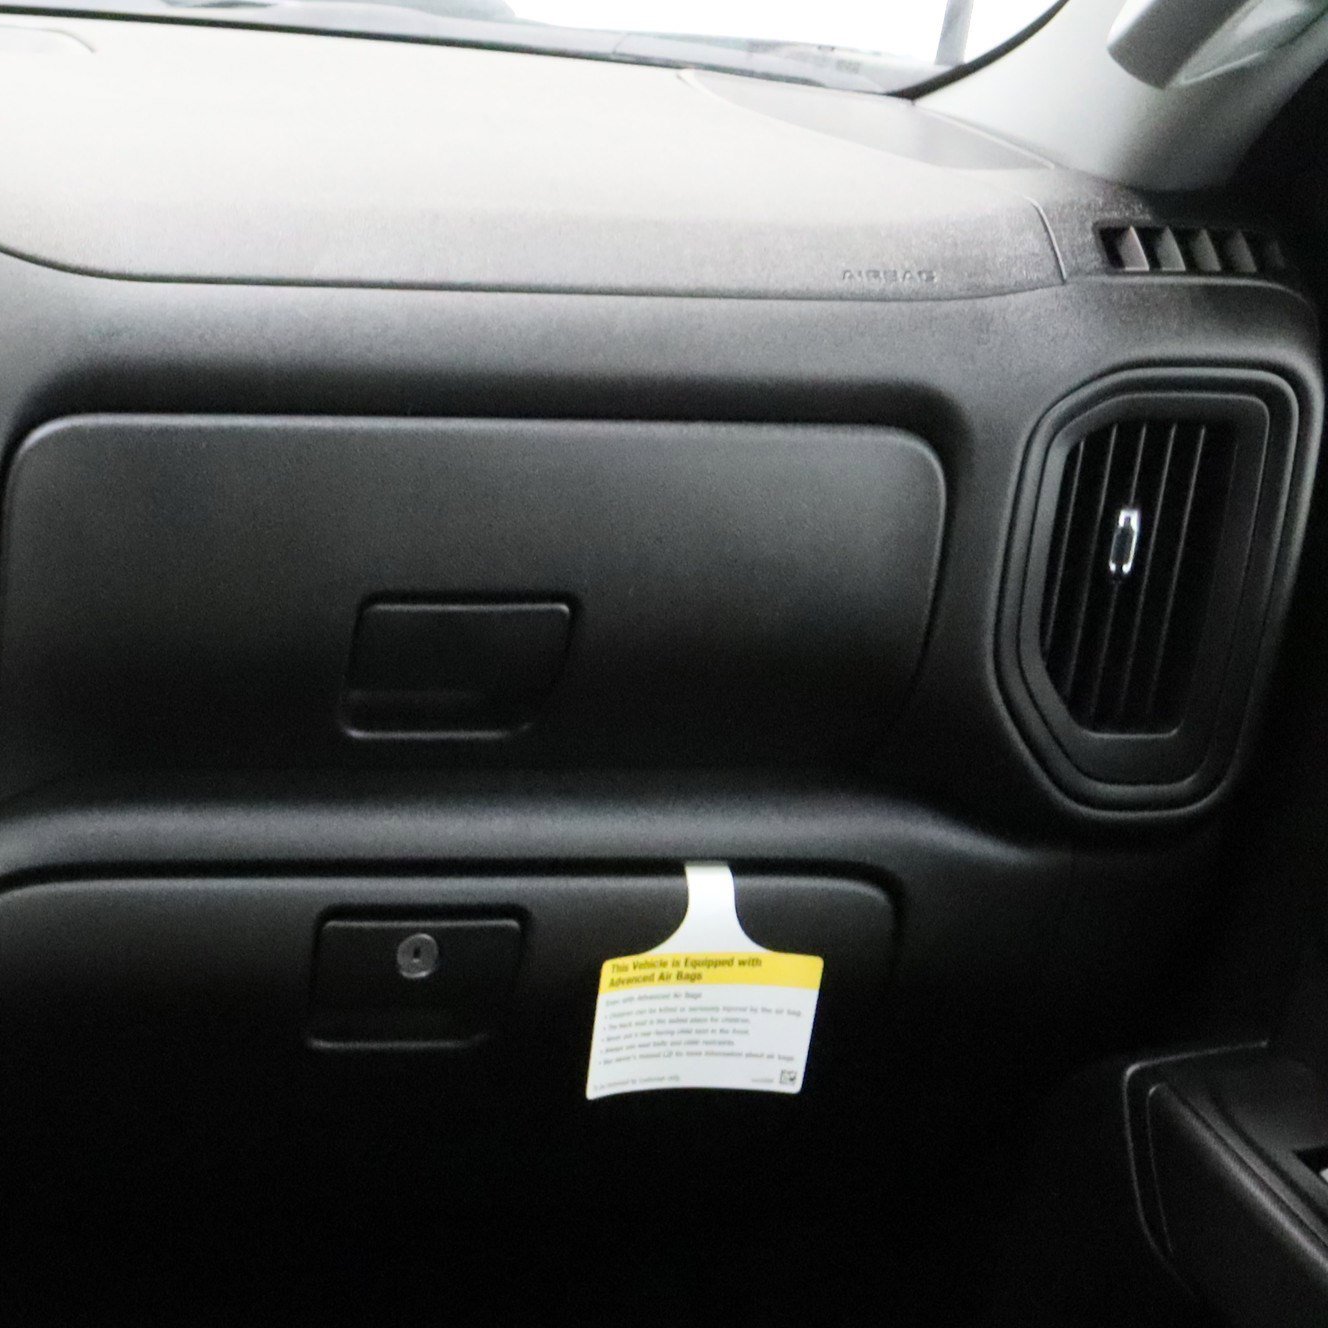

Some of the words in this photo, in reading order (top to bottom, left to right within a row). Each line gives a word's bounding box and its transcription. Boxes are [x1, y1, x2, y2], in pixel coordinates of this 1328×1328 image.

[612, 963, 629, 974] This
[633, 958, 668, 970] Vehicle
[672, 958, 680, 967] is
[685, 957, 734, 970] Equipped
[738, 956, 762, 966] with
[609, 973, 655, 988] Advanced
[658, 972, 672, 982] Air
[676, 971, 703, 983] Bags
